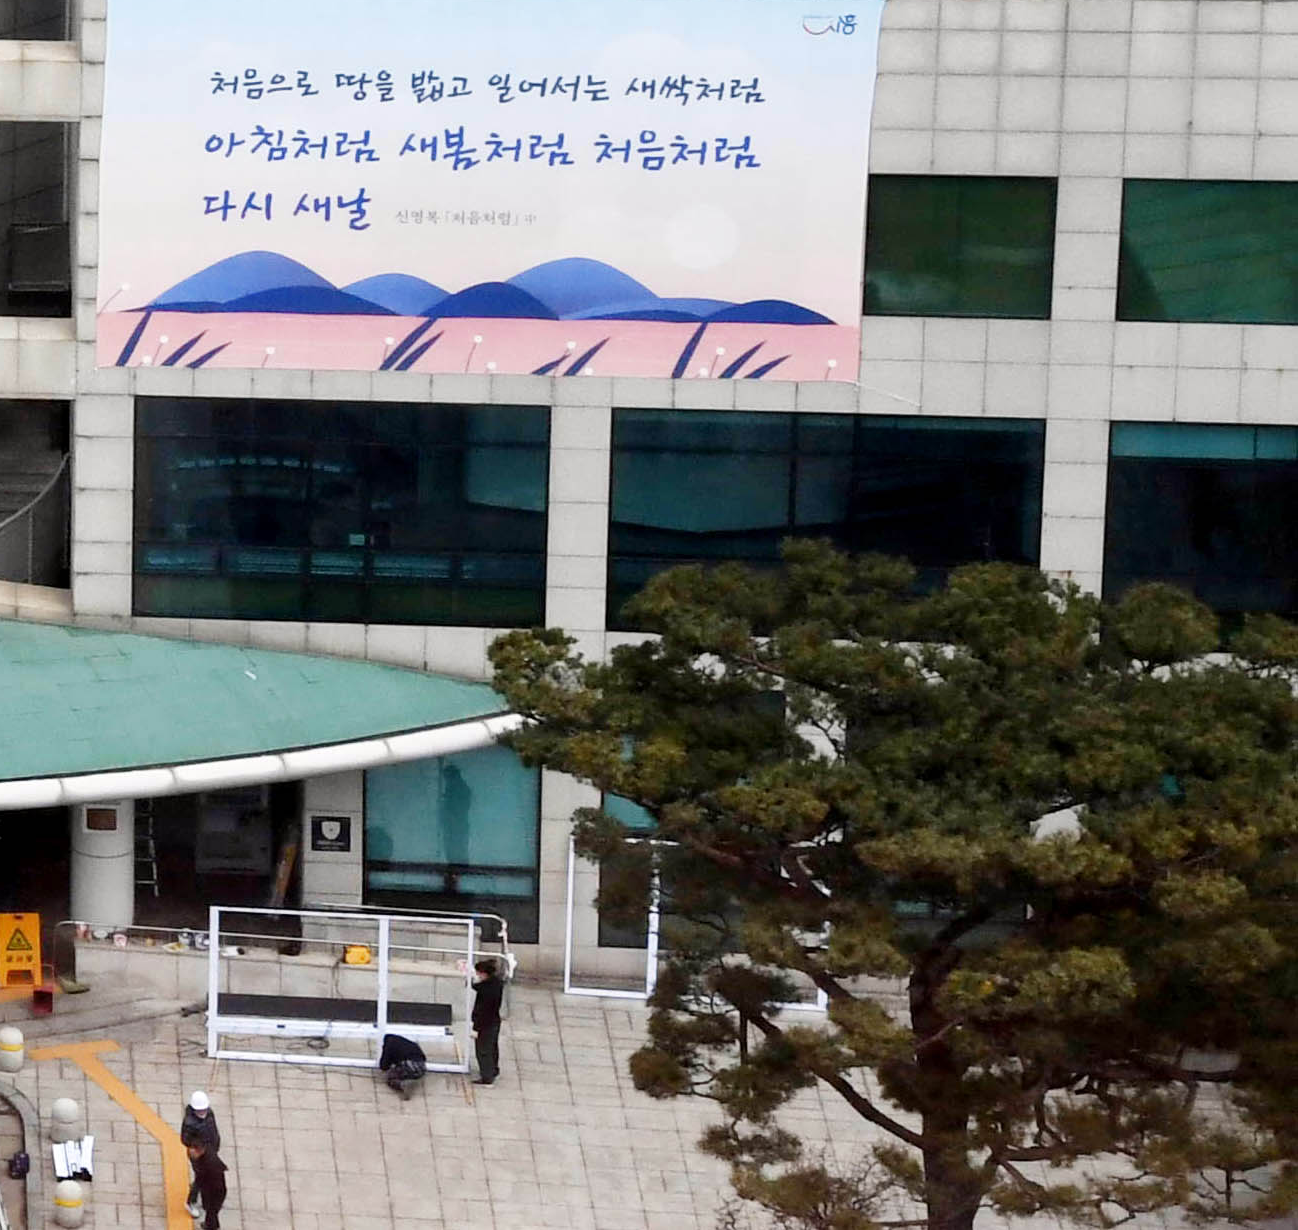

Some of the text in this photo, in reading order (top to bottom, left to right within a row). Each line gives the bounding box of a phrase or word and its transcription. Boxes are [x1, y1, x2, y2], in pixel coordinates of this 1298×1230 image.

[209, 68, 767, 107] 처음으로 땅을 밟고 일어서는 새싹처럼
[203, 125, 762, 172] 아침처럼 새봄처럼 처음처럼
[203, 187, 372, 231] 다시 새날
